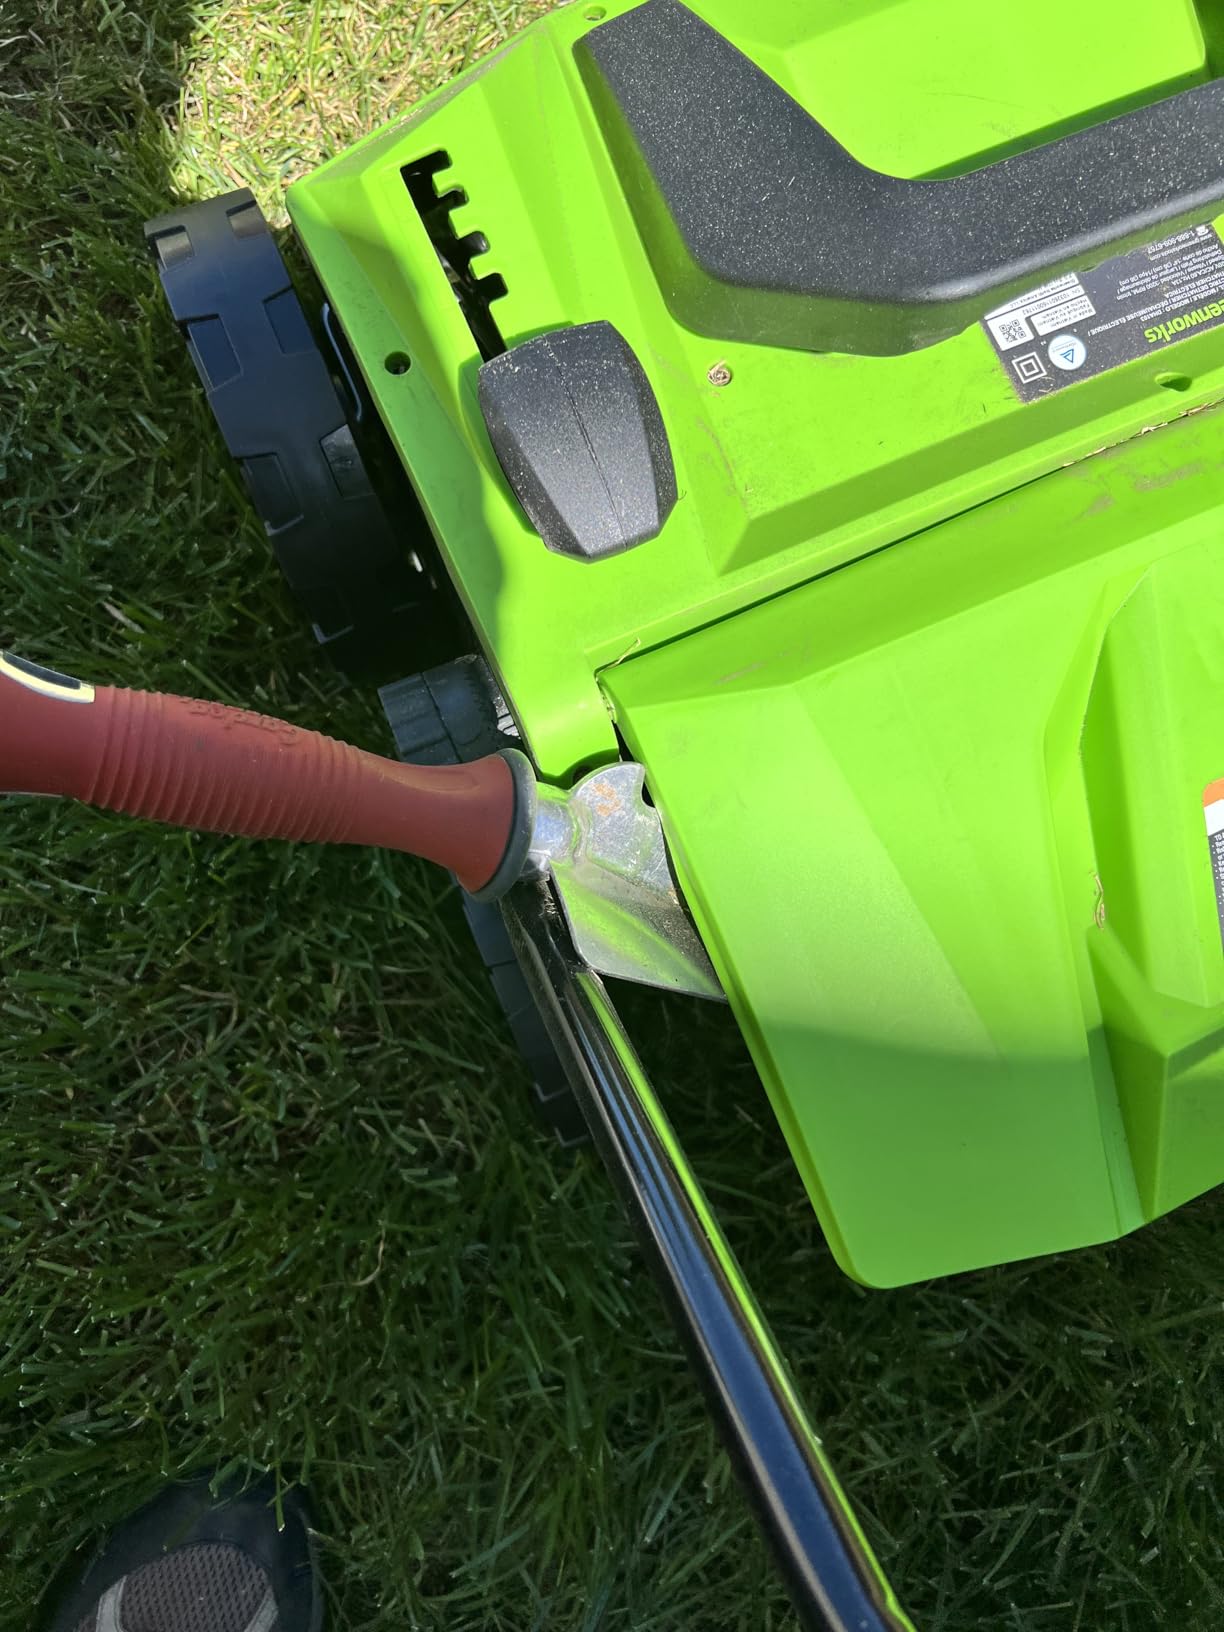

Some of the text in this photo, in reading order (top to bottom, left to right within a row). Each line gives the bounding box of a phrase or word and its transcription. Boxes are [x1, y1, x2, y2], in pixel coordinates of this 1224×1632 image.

[1170, 283, 1208, 302] DETHATCHER
[1125, 299, 1169, 321] DÉCHAUMEUSE
[1164, 298, 1189, 311] MODELO
[1089, 316, 1126, 334] ÉLECTRIQUE
